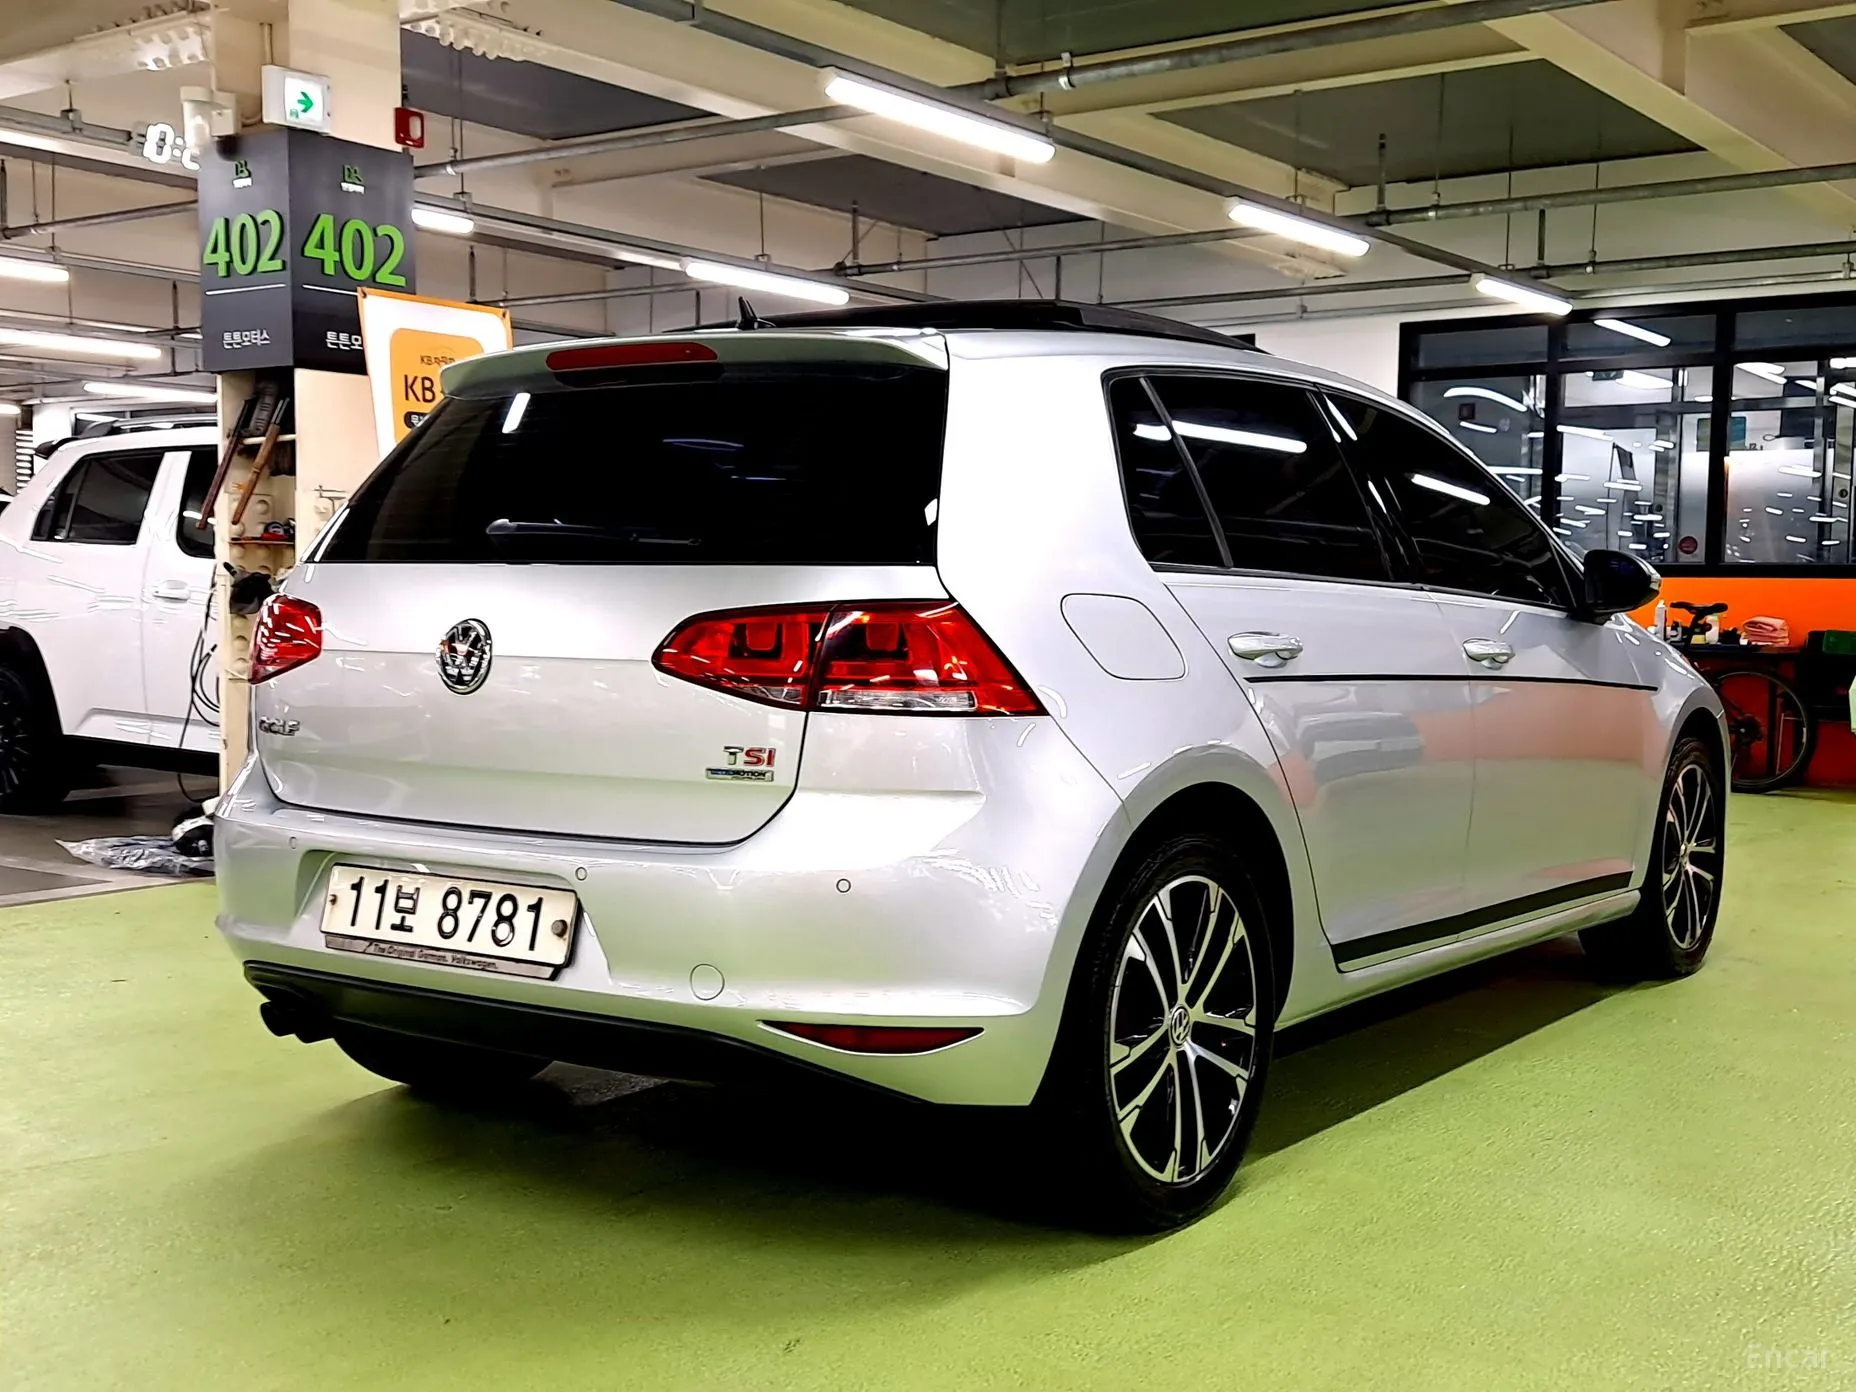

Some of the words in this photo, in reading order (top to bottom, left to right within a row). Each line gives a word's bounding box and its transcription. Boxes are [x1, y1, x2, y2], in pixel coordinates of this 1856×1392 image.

[203, 209, 286, 277] 402
[303, 213, 407, 287] 402
[223, 329, 271, 349] 튼튼모터스
[404, 374, 443, 403] KB
[259, 716, 300, 737] GOLF
[723, 746, 776, 767] TSI
[349, 876, 421, 932] 11보
[437, 886, 544, 951] 8781
[373, 943, 386, 954] The
